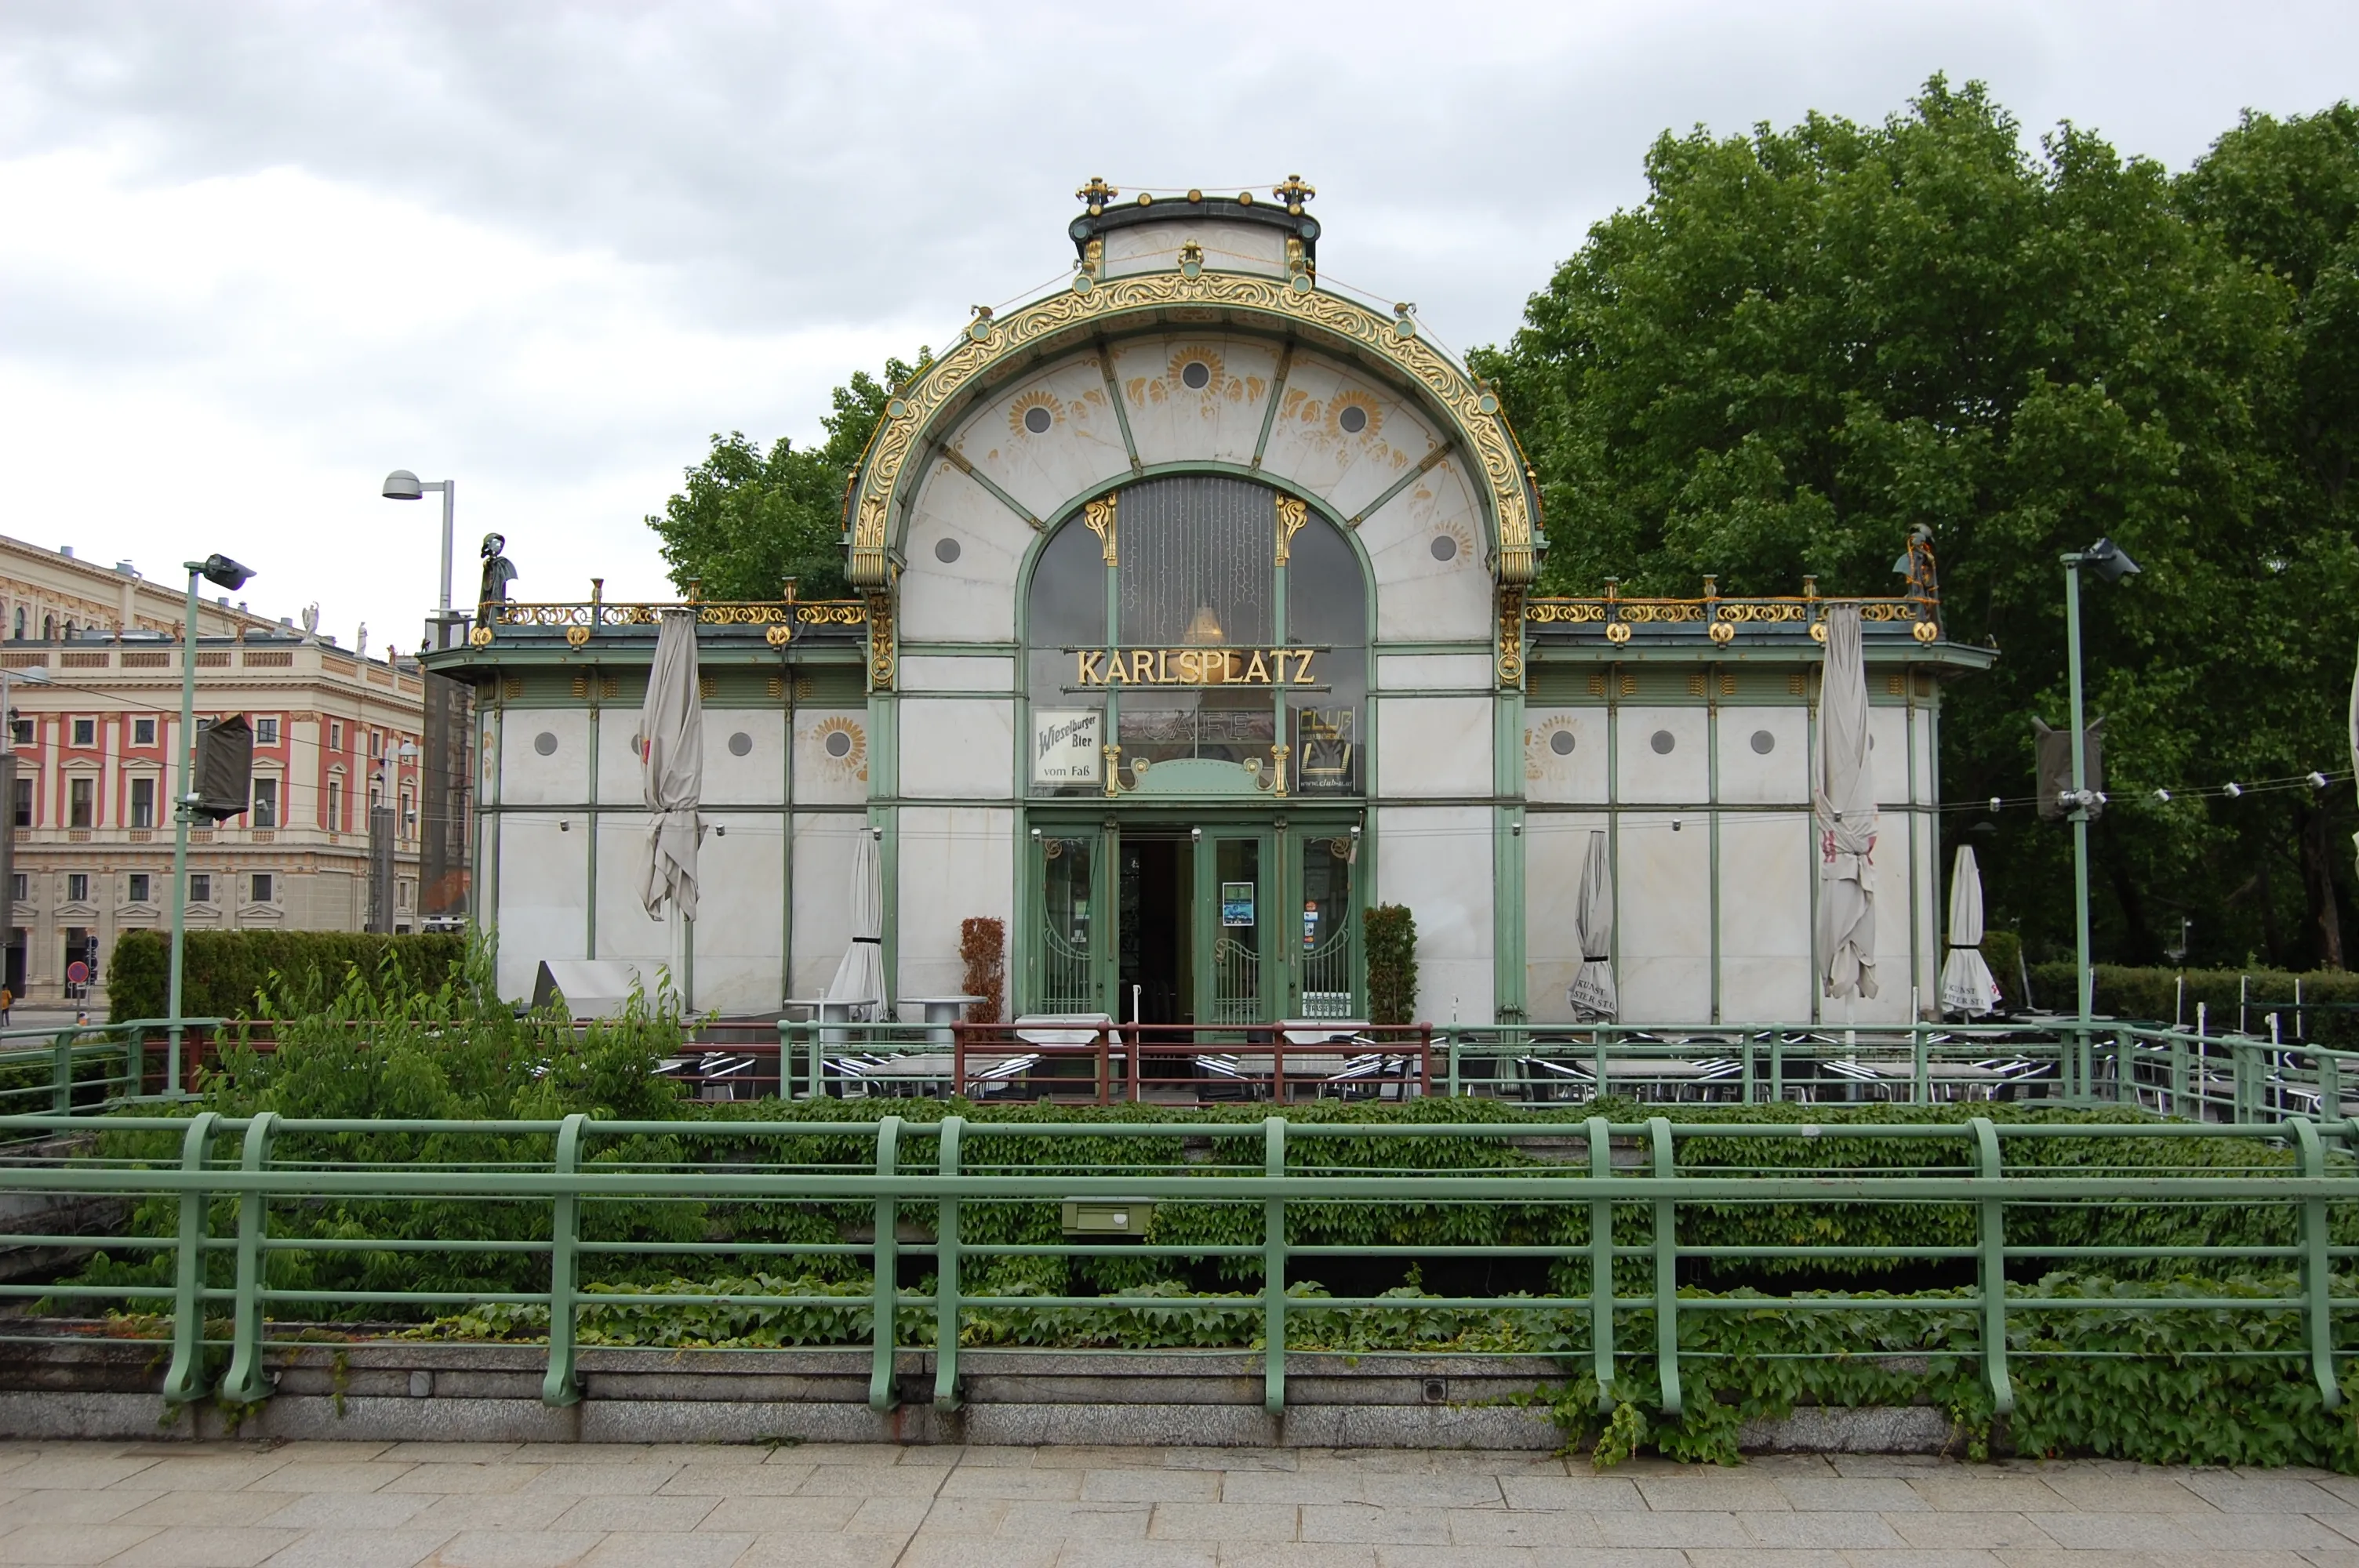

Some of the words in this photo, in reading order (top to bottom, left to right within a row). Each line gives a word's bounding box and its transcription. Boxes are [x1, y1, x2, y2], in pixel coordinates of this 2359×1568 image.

[1077, 650, 1315, 683] KARLSPLATZ
[1143, 713, 1249, 740] CAFE
[1300, 710, 1352, 731] CLUB
[1038, 716, 1096, 760] Wieselburger
[1072, 734, 1092, 747] Bier
[1071, 765, 1090, 776] Faß
[1577, 979, 1605, 996] KUNST
